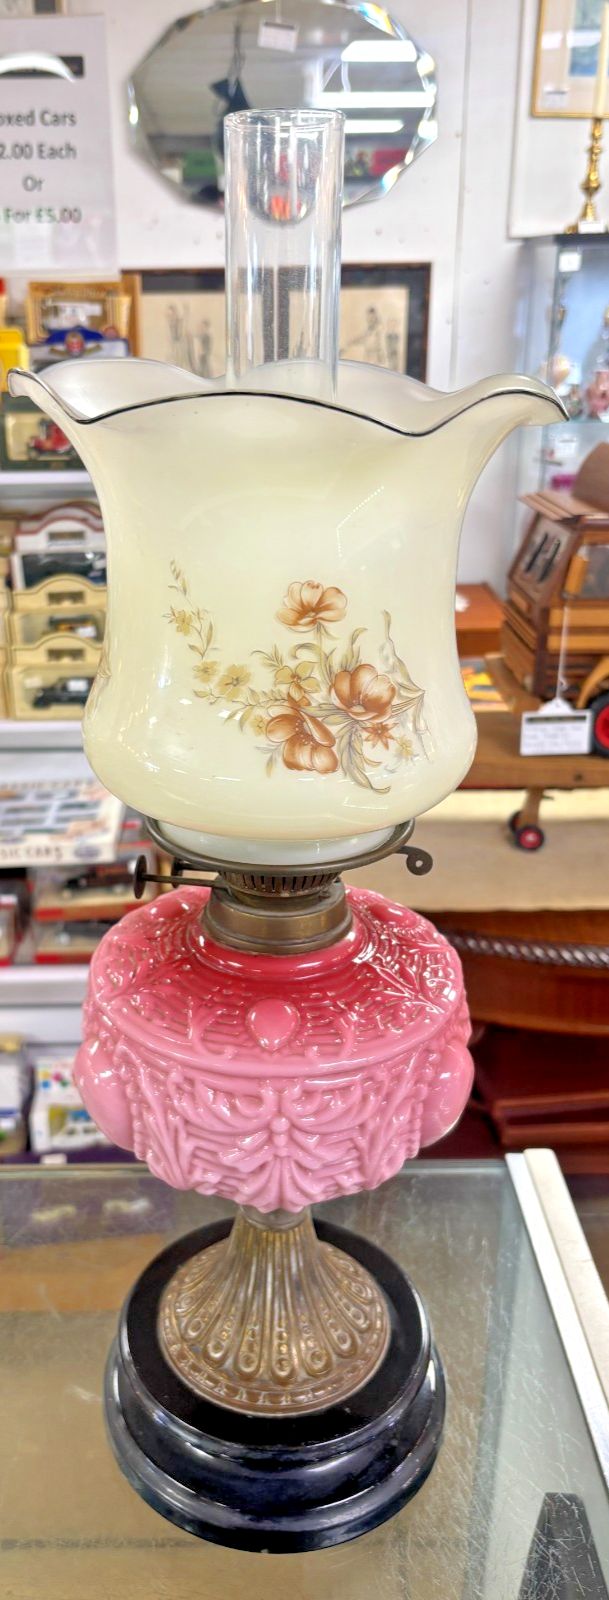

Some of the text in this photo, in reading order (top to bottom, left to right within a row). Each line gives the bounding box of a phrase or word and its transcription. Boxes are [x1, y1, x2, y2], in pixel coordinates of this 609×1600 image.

[40, 110, 77, 127] Cars
[38, 142, 77, 160] Each
[22, 175, 44, 192] Or
[3, 207, 82, 224] For £5.00
